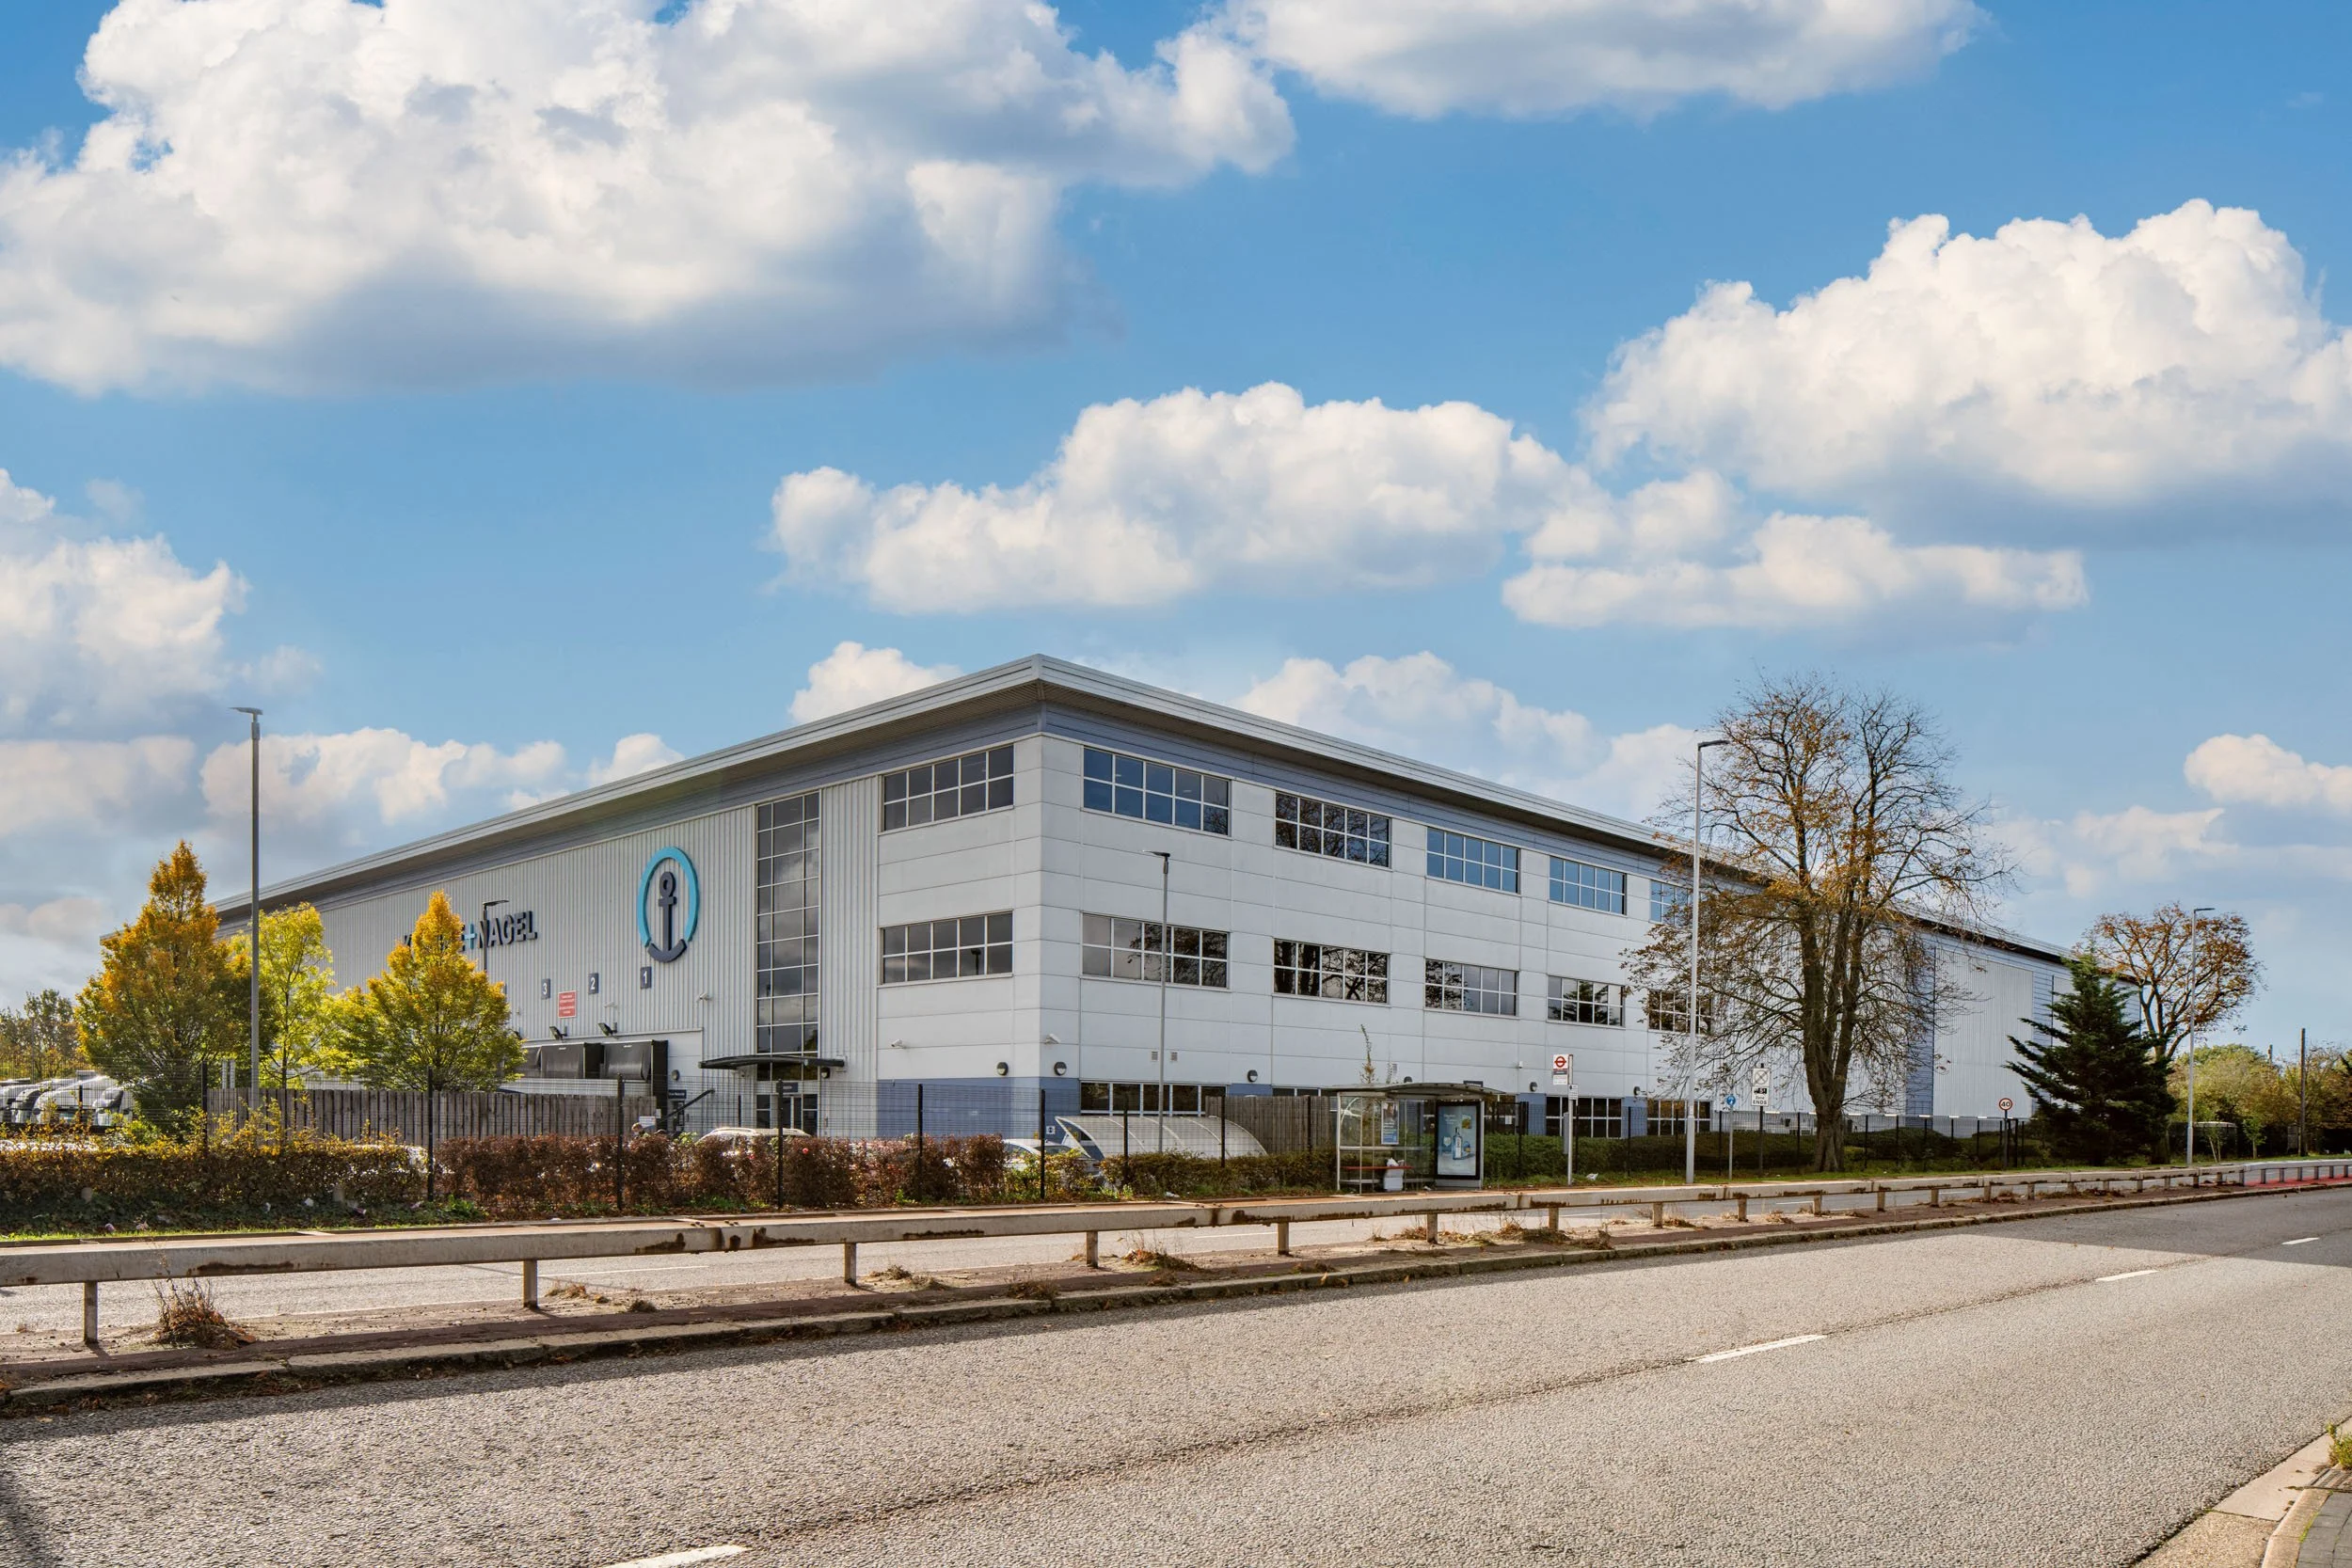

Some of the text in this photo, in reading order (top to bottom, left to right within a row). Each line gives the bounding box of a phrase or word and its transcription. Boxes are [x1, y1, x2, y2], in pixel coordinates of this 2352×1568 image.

[590, 976, 596, 990] 2
[643, 970, 648, 985] 1
[542, 982, 548, 995] 3
